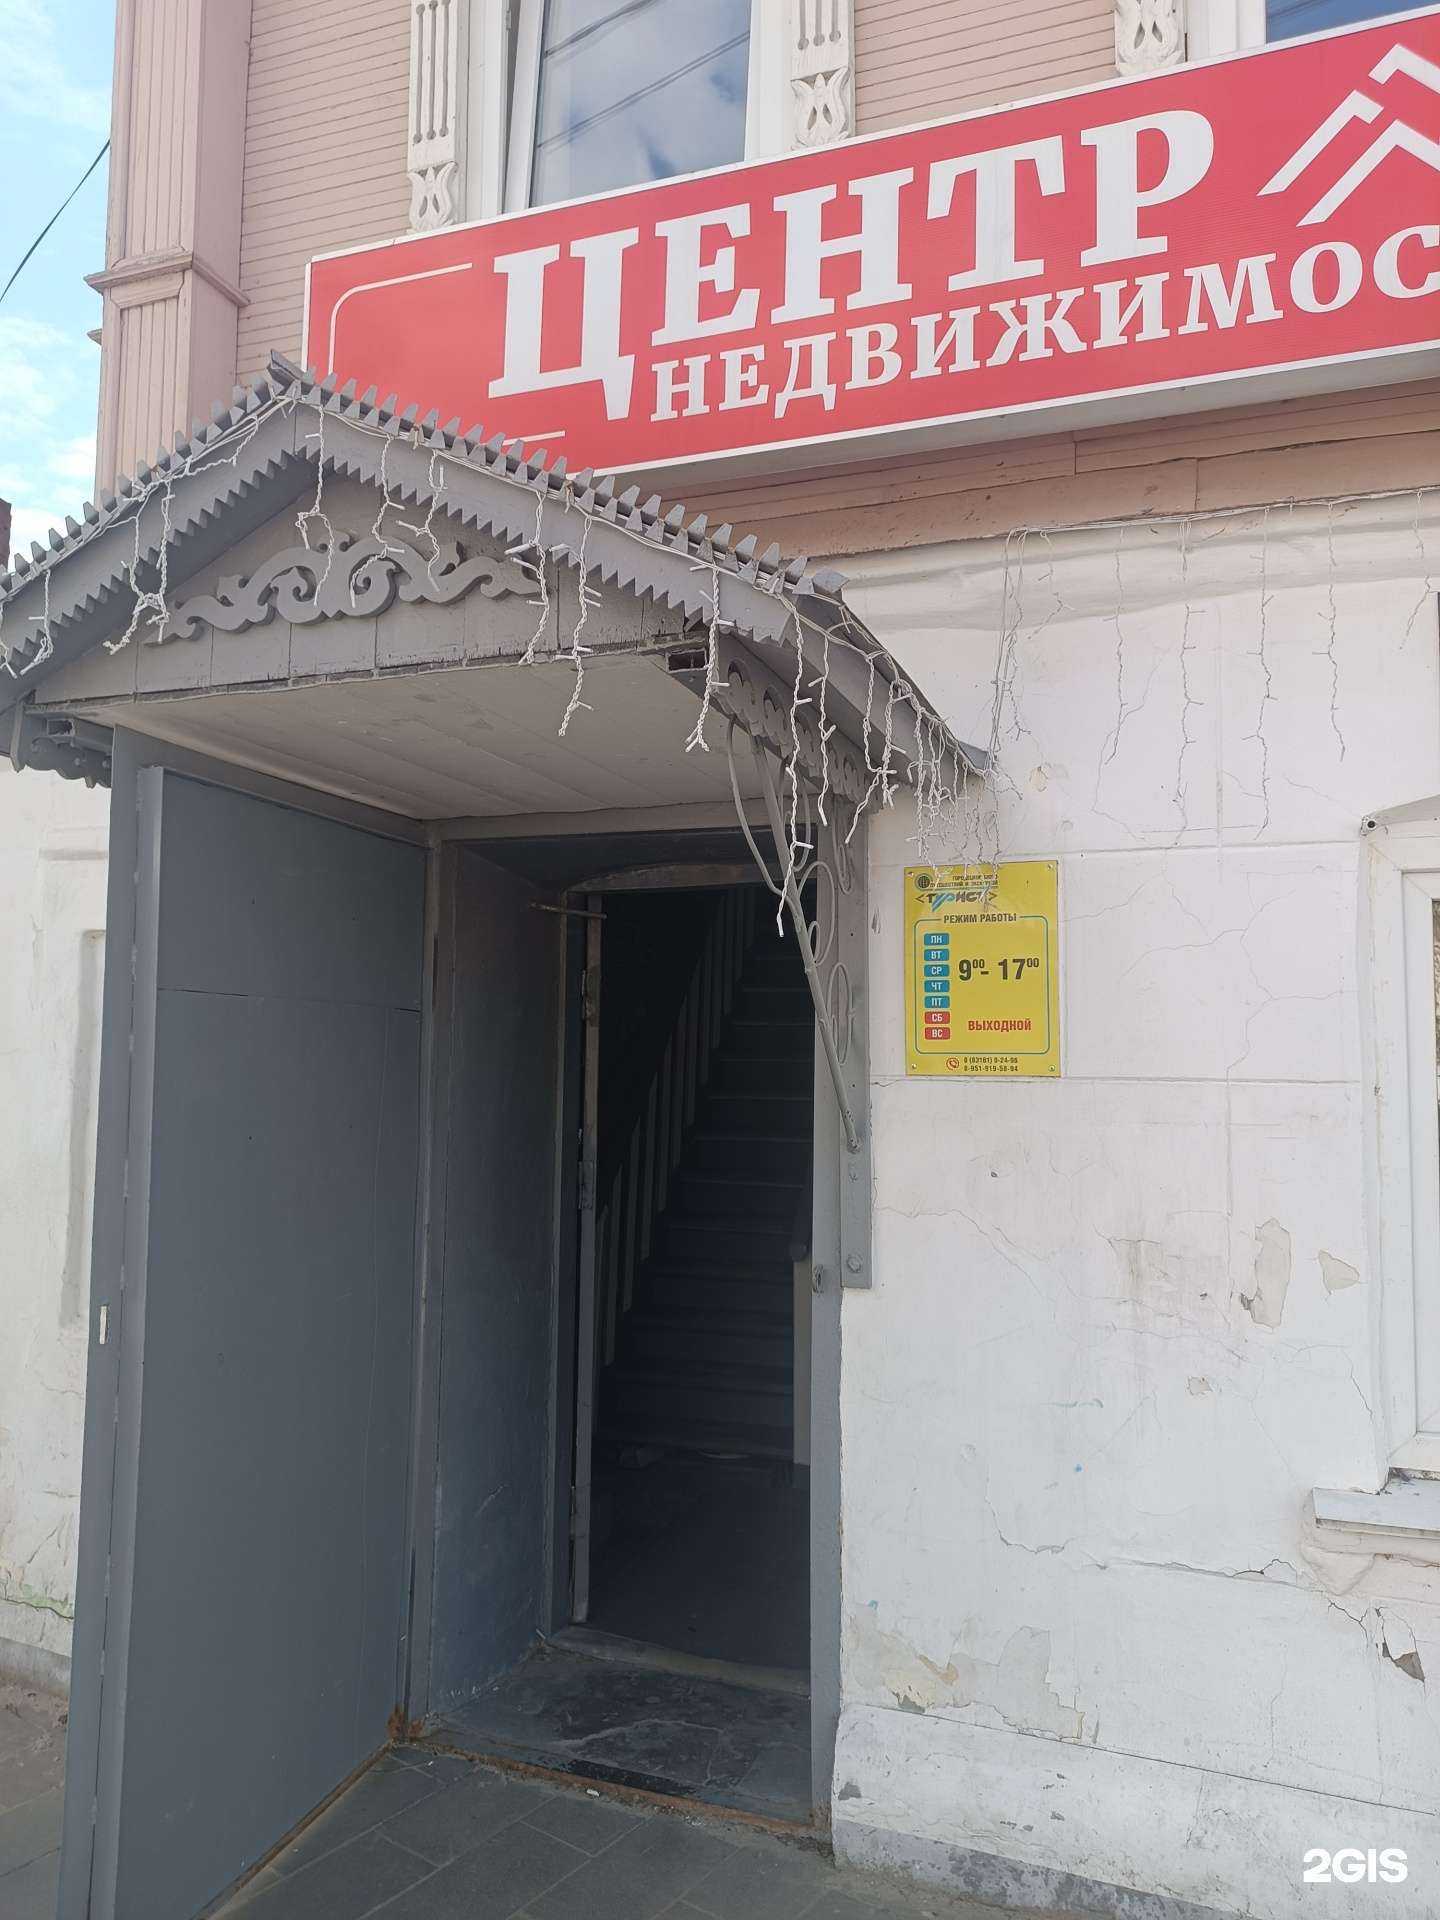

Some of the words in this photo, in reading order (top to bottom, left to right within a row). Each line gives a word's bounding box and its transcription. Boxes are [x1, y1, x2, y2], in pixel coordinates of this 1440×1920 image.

[488, 109, 1214, 421] ЦЕНТР
[650, 224, 1440, 422] НЕДВИЖИМОС
[943, 914, 977, 924] РЕЖИМ
[980, 913, 1017, 923] РАБОТЫ
[930, 935, 943, 944] ПН
[931, 951, 942, 960] ВТ
[931, 966, 942, 975] СР
[931, 982, 942, 990] ЧТ
[931, 998, 942, 1006] ПТ
[931, 1013, 943, 1022] СБ
[968, 1018, 1032, 1032] ВЫХОДНОЙ
[931, 1029, 943, 1038] ВС
